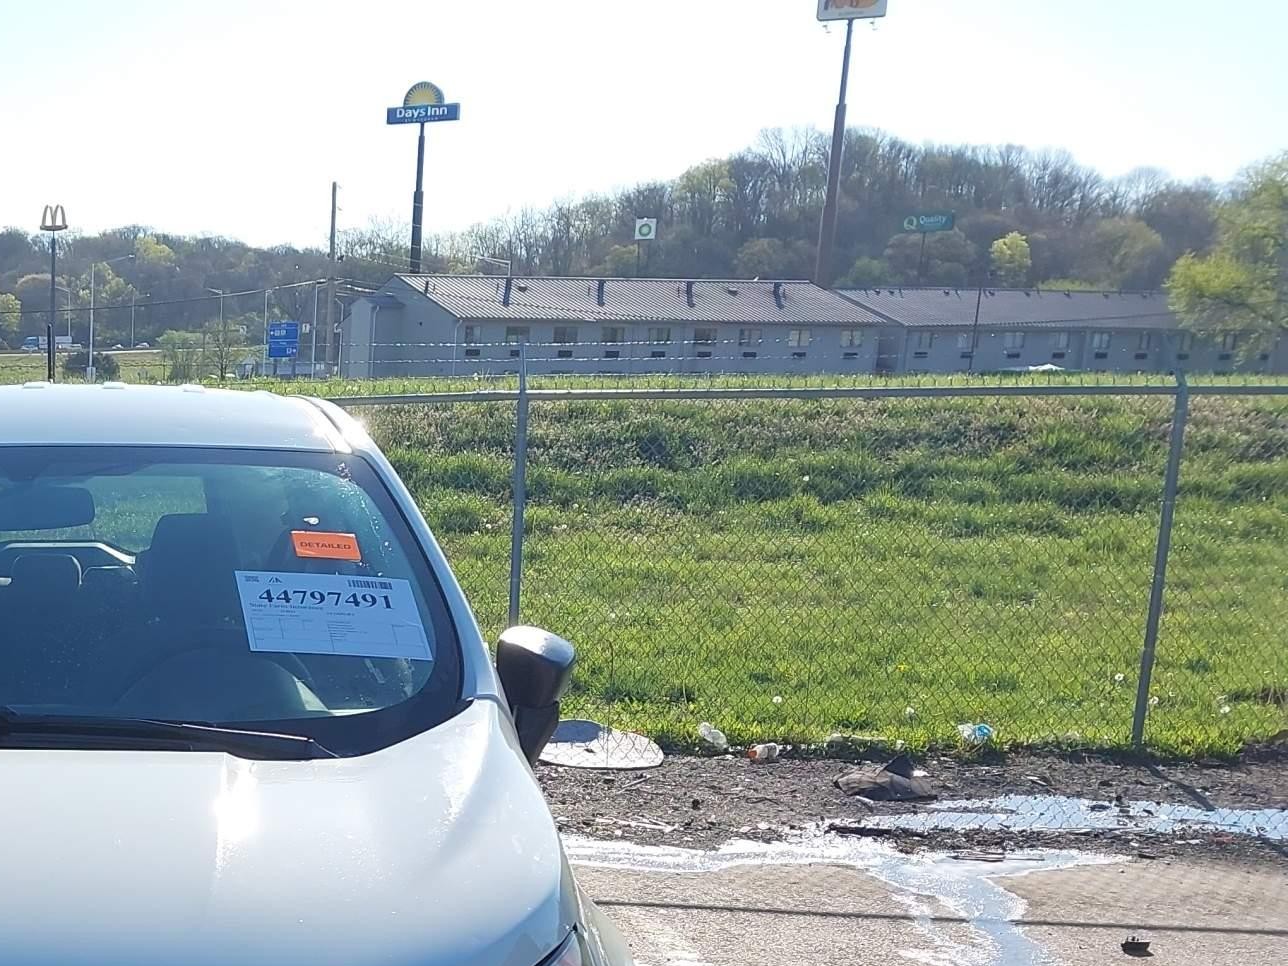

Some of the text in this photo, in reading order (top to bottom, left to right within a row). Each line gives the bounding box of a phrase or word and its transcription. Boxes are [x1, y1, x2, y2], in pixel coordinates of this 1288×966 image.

[396, 106, 448, 118] Days Inn
[919, 215, 946, 225] Quality
[299, 541, 352, 550] DETAILED
[258, 588, 394, 610] 44797491
